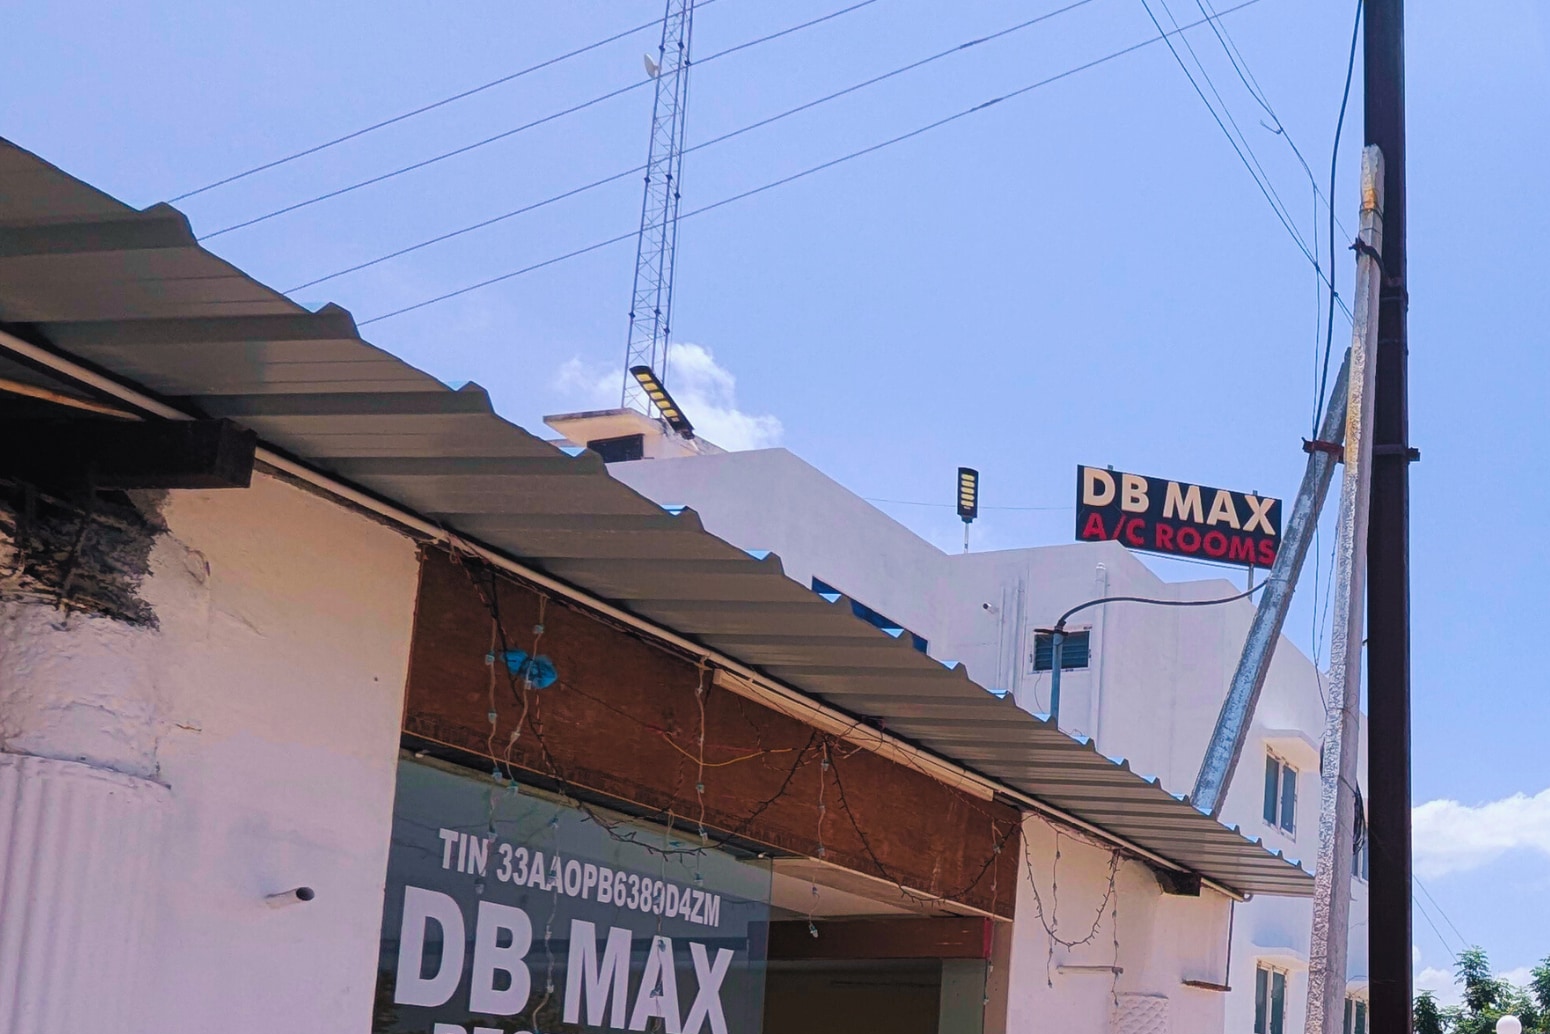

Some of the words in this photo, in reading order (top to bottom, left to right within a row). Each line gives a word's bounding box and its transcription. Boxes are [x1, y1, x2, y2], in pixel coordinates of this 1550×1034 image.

[1083, 467, 1149, 513] DB
[1163, 481, 1276, 536] MAX
[1082, 512, 1146, 548] A/C
[1156, 522, 1277, 566] ROOMS
[439, 828, 489, 877] TIN
[394, 885, 533, 1017] DB
